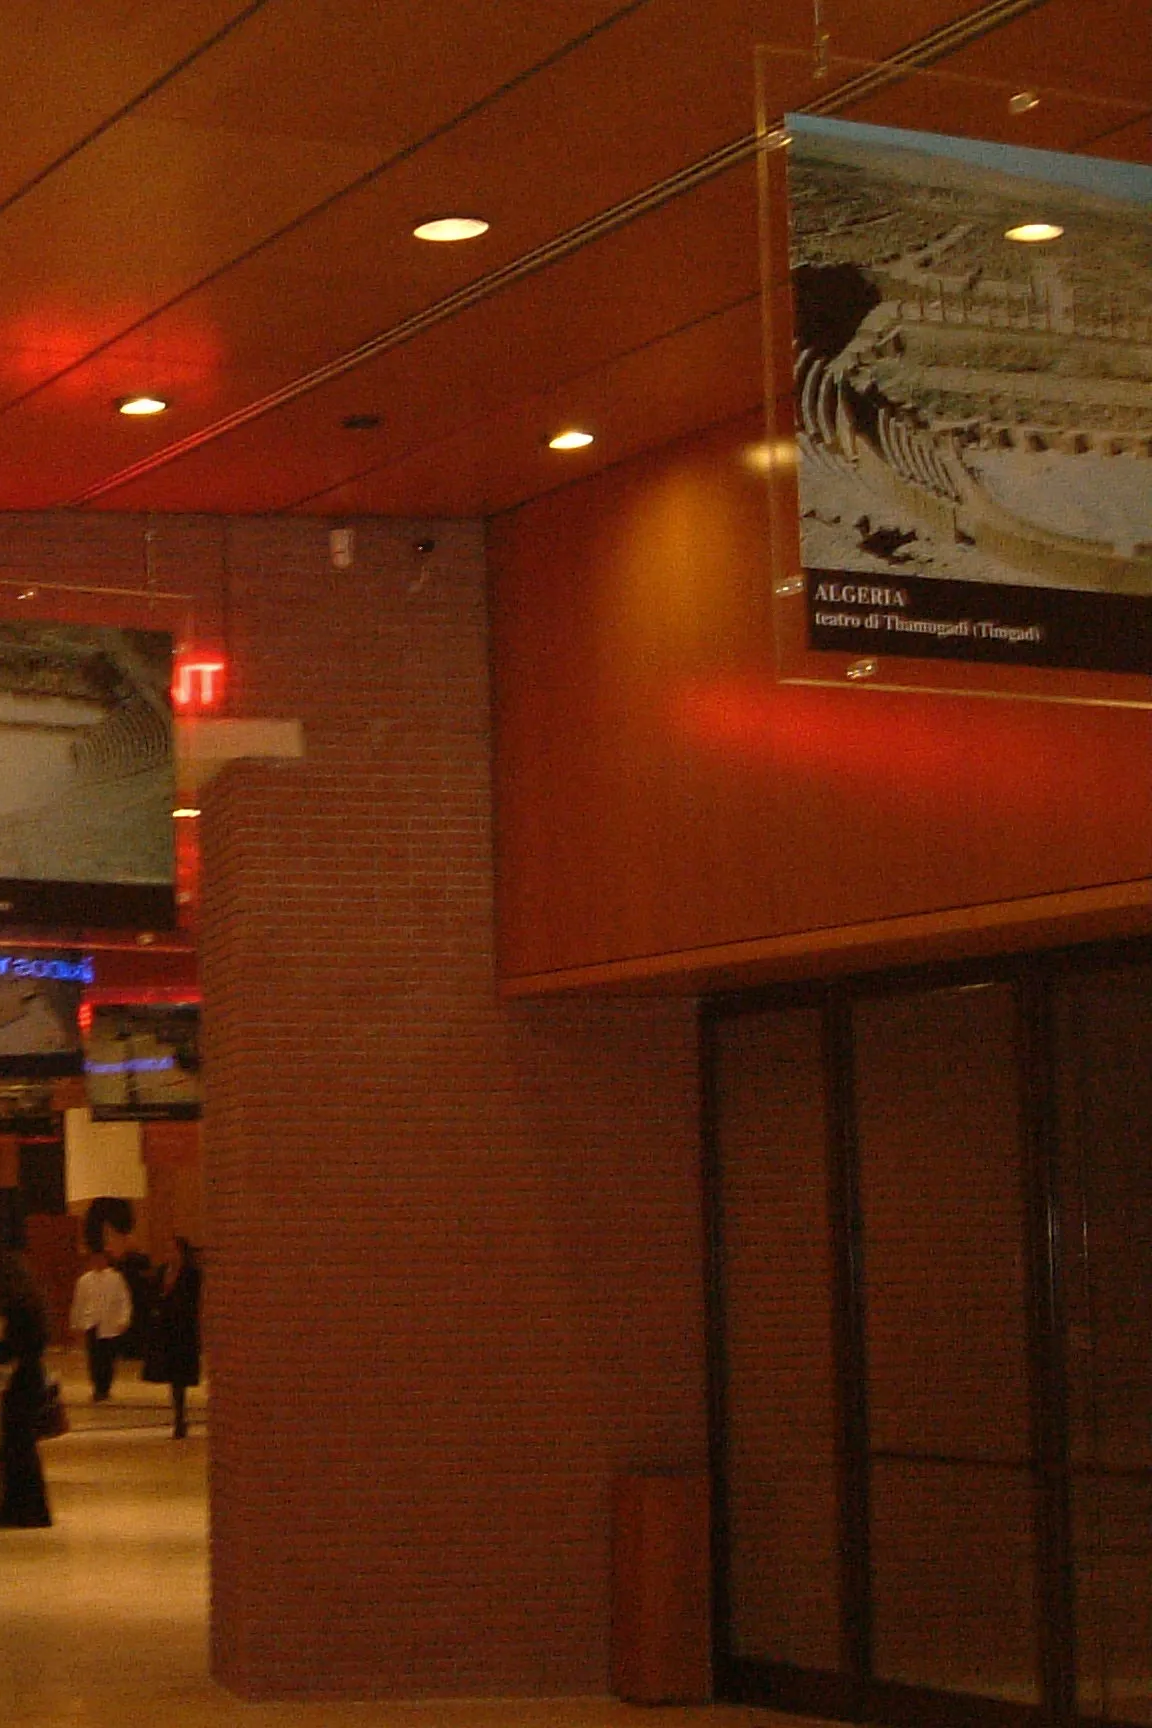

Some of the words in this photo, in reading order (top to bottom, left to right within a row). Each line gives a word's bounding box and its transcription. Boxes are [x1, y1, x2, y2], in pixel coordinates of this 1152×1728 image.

[815, 583, 906, 607] ALGERIA
[815, 611, 861, 628] teatro
[864, 616, 879, 629] di
